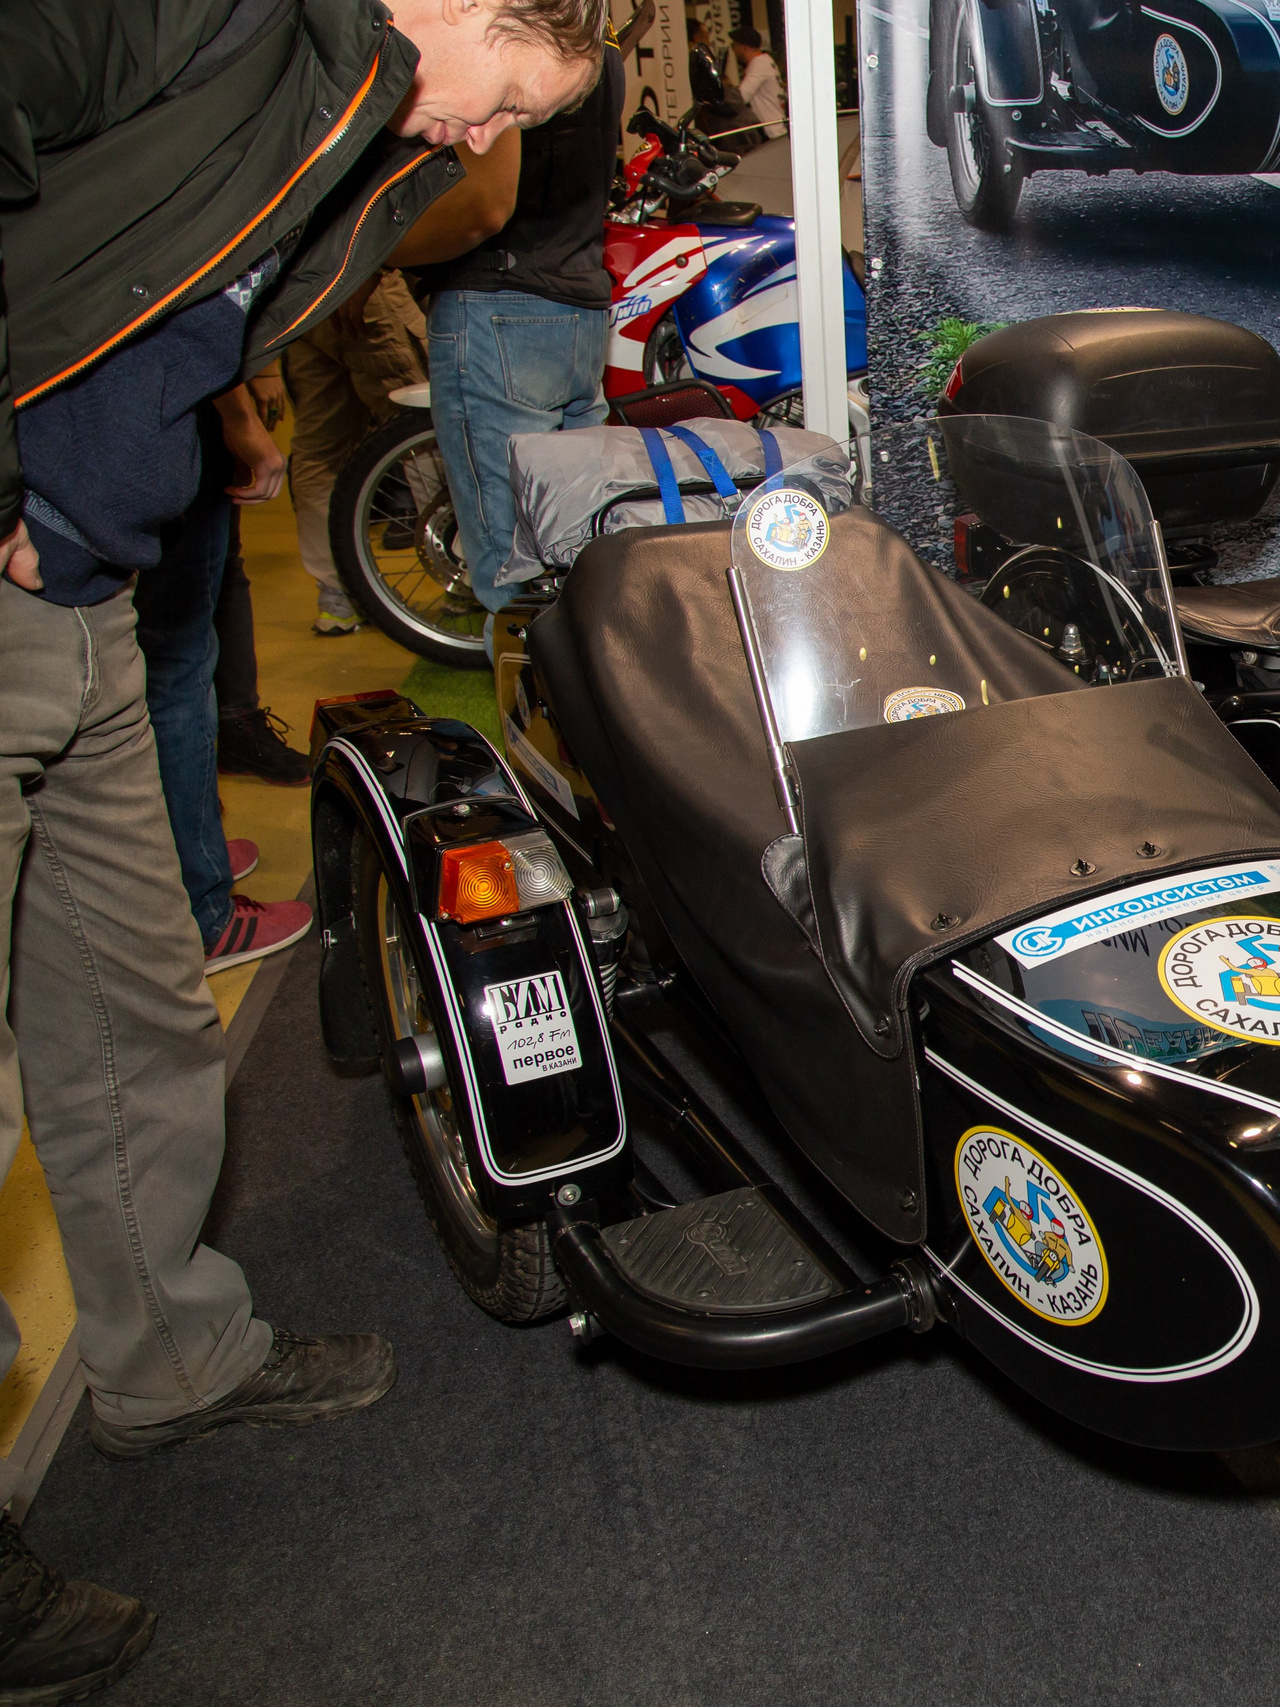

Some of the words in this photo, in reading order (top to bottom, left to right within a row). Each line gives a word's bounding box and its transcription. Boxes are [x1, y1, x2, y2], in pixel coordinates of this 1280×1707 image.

[608, 294, 652, 328] Twin
[751, 496, 783, 531] ДОРОГА
[784, 494, 818, 517] ДОБРА
[753, 537, 798, 567] САХАЛИН
[804, 520, 826, 560] КАЗАНЬ
[1085, 893, 1223, 939] научно-инженерный
[1228, 886, 1265, 897] центр
[1171, 928, 1225, 988] ДОРОГА
[490, 975, 563, 1023] БИМ
[499, 1011, 567, 1034] радио
[507, 1032, 544, 1050] 102,8
[513, 1045, 575, 1069] первое
[549, 1057, 578, 1070] КАЗАНИ
[963, 1138, 1025, 1181] ДОРОГА
[1027, 1159, 1092, 1246] ДОБРА
[964, 1185, 1030, 1299] САХАЛИН
[1046, 1263, 1098, 1315] КАЗАНЬ
